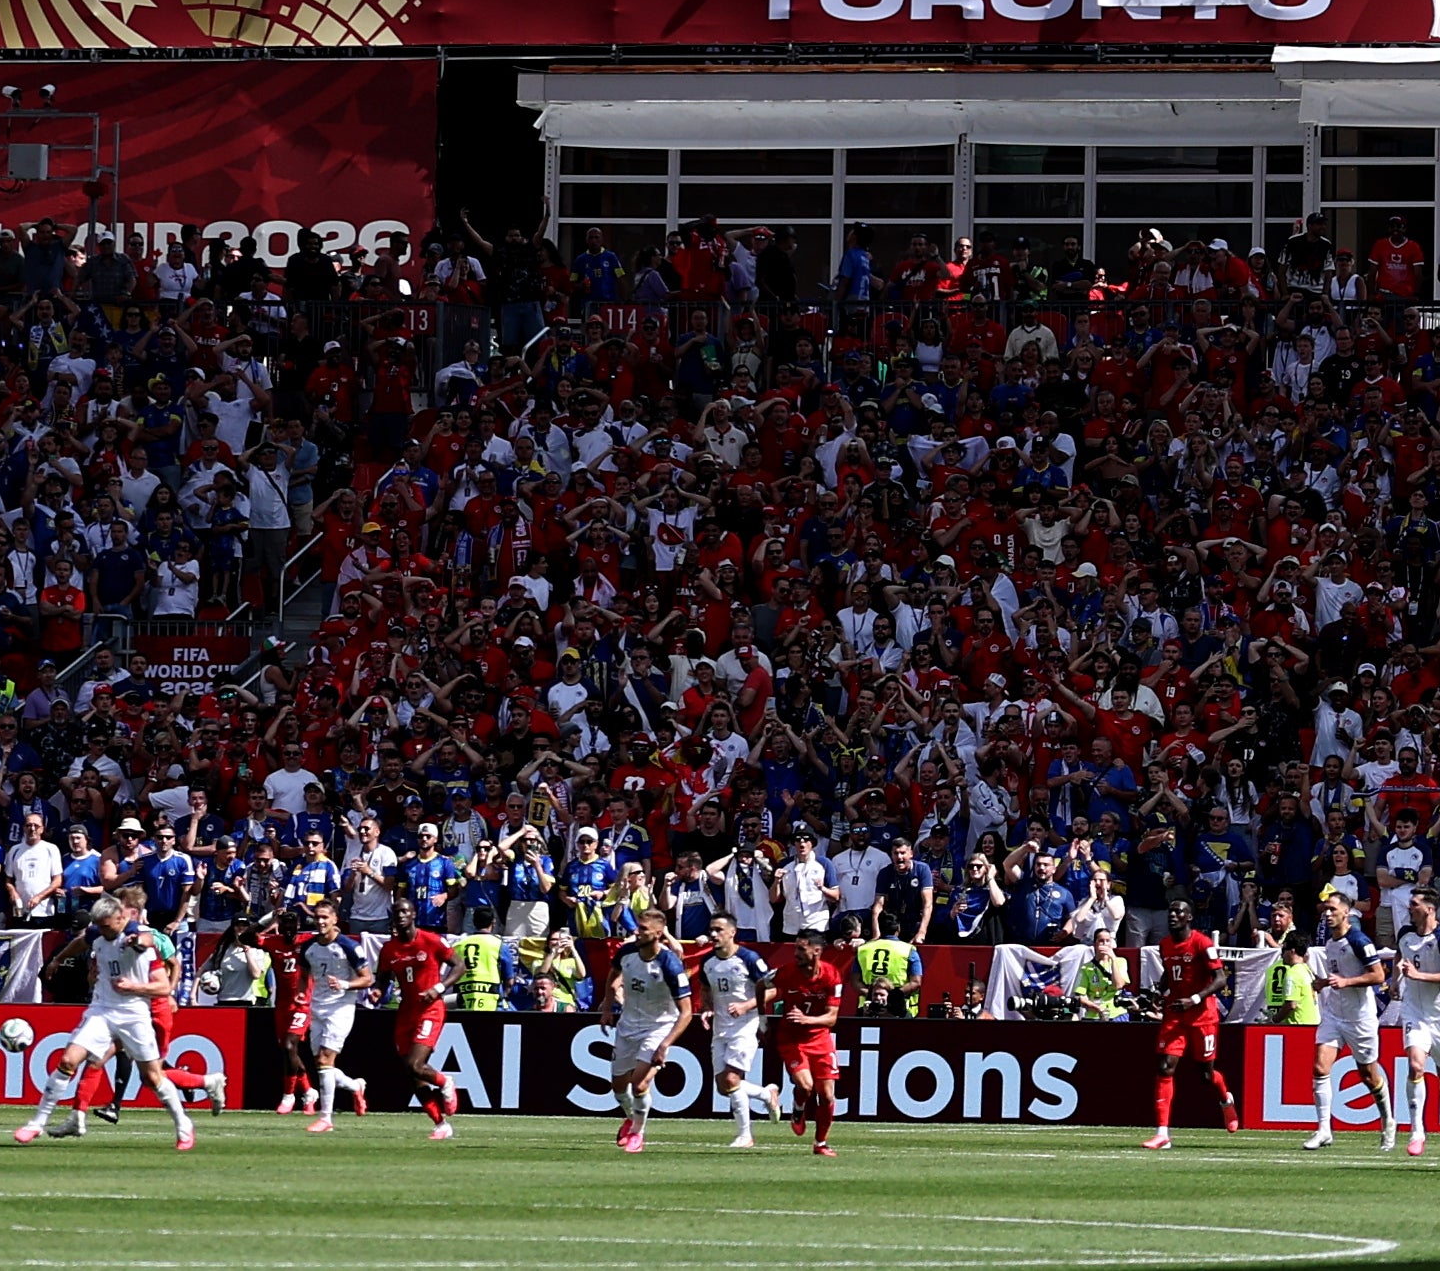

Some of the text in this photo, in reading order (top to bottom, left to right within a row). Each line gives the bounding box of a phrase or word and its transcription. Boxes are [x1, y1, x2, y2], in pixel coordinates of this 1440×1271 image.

[408, 309, 431, 331] 13
[606, 308, 638, 331] 114
[173, 647, 210, 662] FIFA
[1166, 687, 1175, 697] 19
[158, 876, 165, 888] 7
[417, 887, 427, 899] 11
[577, 885, 592, 897] 20
[109, 960, 121, 976] 10
[406, 967, 414, 983] 8
[1172, 965, 1183, 981] 12
[717, 977, 729, 992] 13
[409, 1024, 521, 1109] AI
